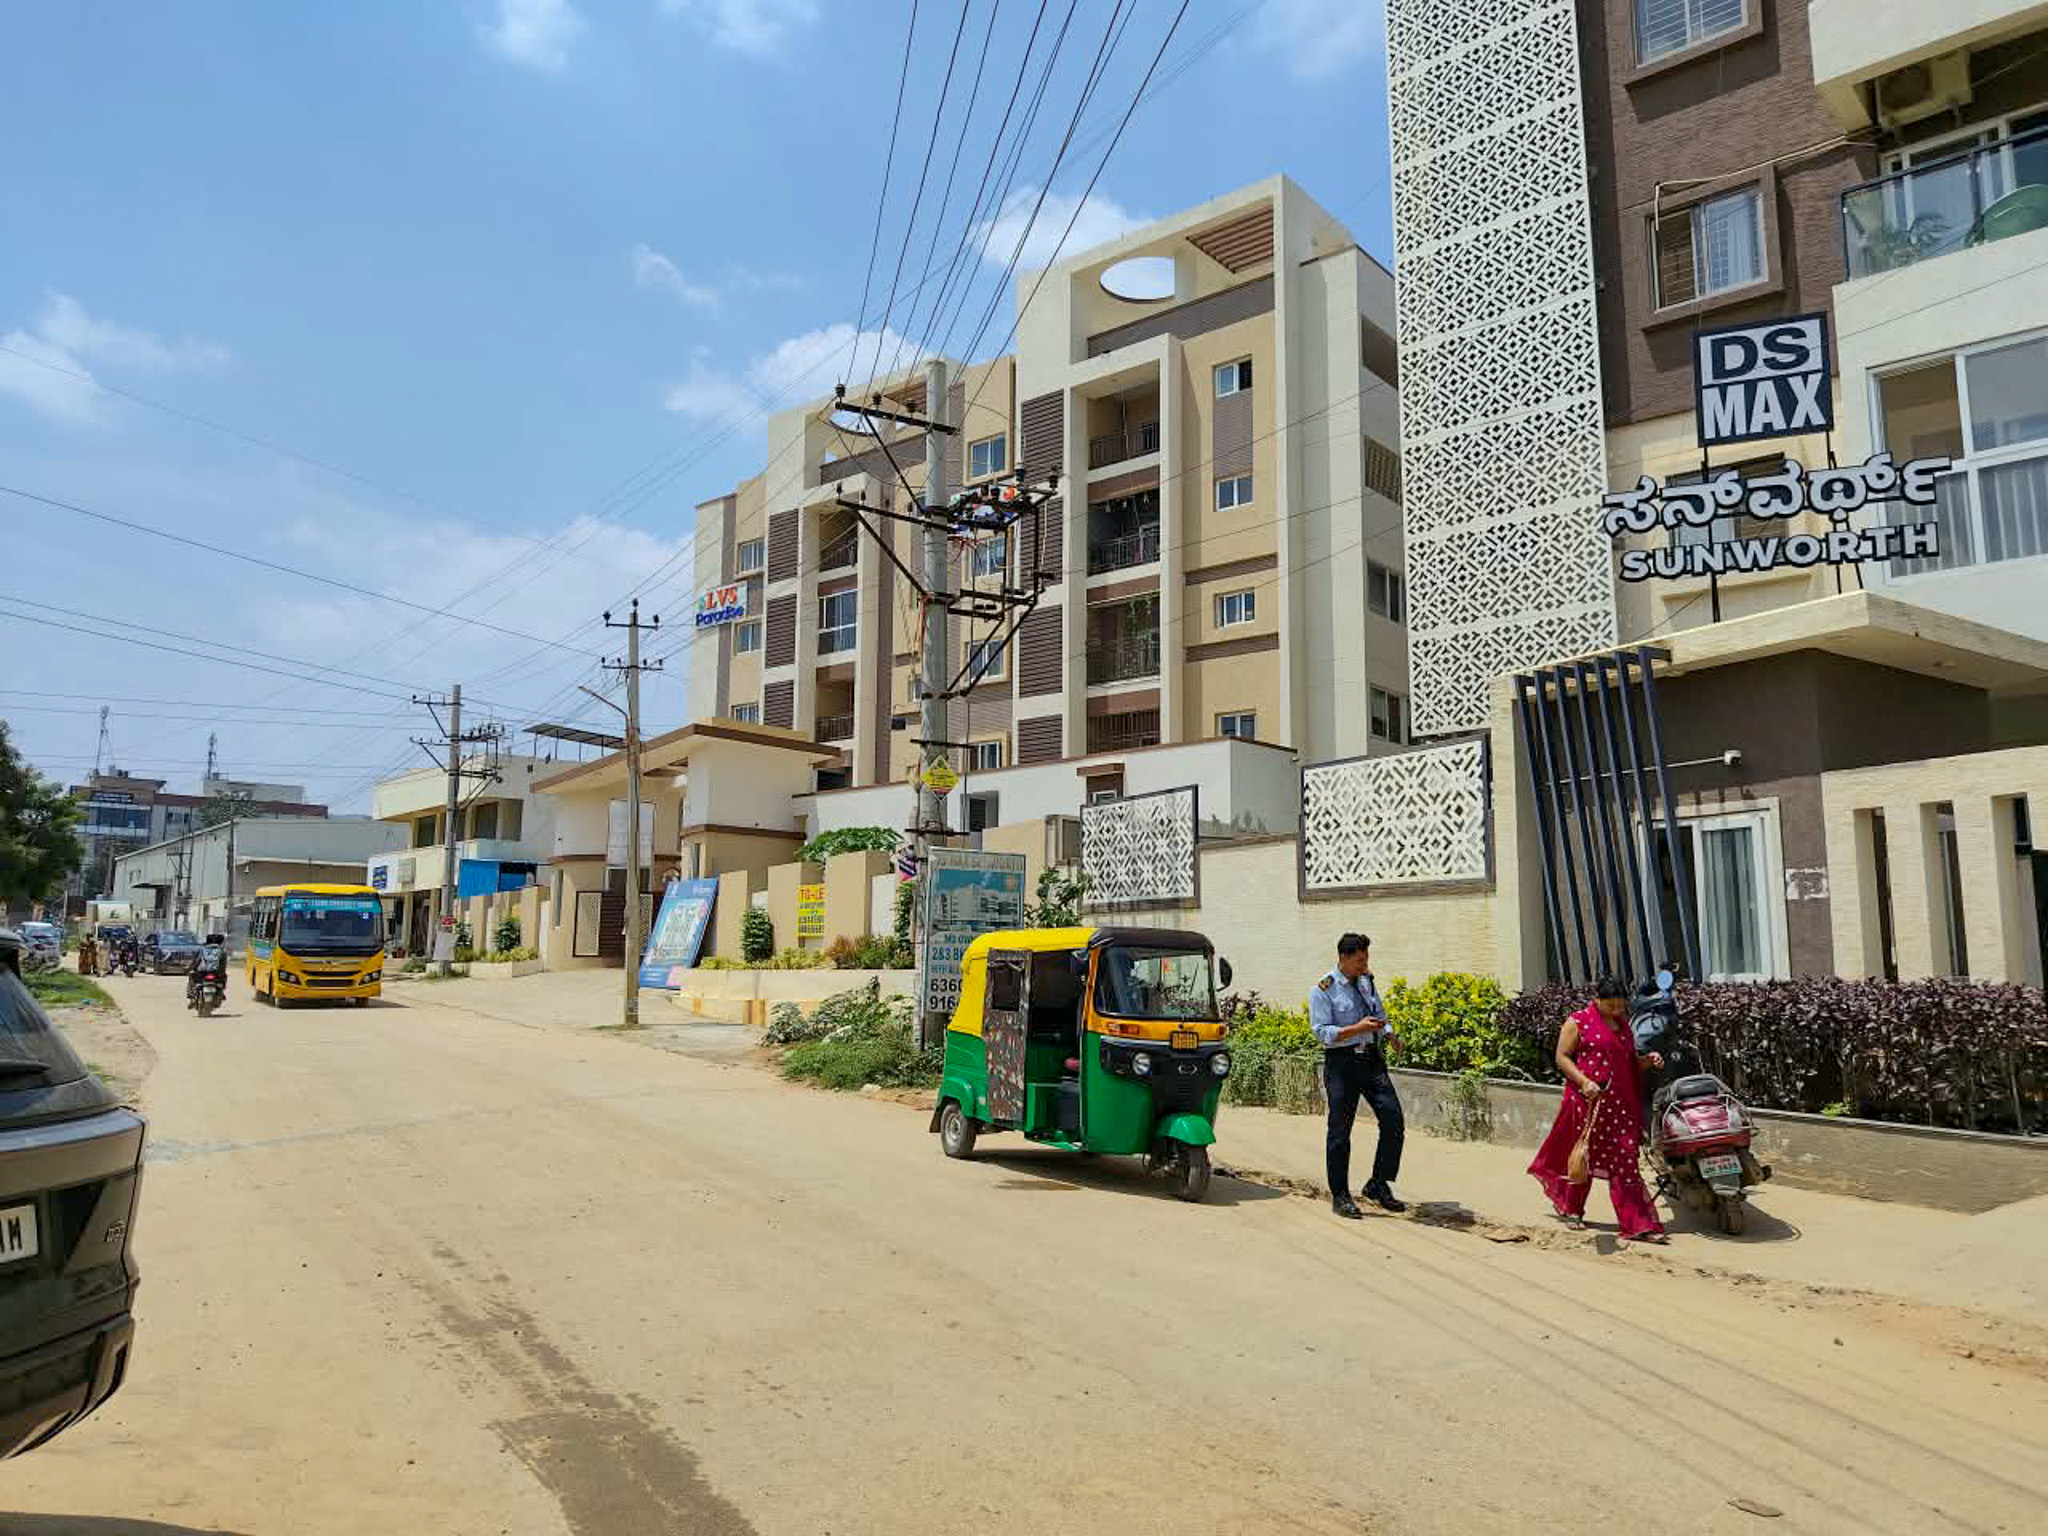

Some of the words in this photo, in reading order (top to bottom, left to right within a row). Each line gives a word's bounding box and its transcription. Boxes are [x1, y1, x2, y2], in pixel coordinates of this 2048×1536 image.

[1710, 327, 1811, 381] DS
[1703, 373, 1827, 439] MAX
[1621, 522, 1939, 582] SUNWORTH
[696, 606, 744, 627] Paradise
[800, 888, 825, 900] TO-LE
[930, 996, 959, 1010] 916
[0, 1216, 22, 1254] M
